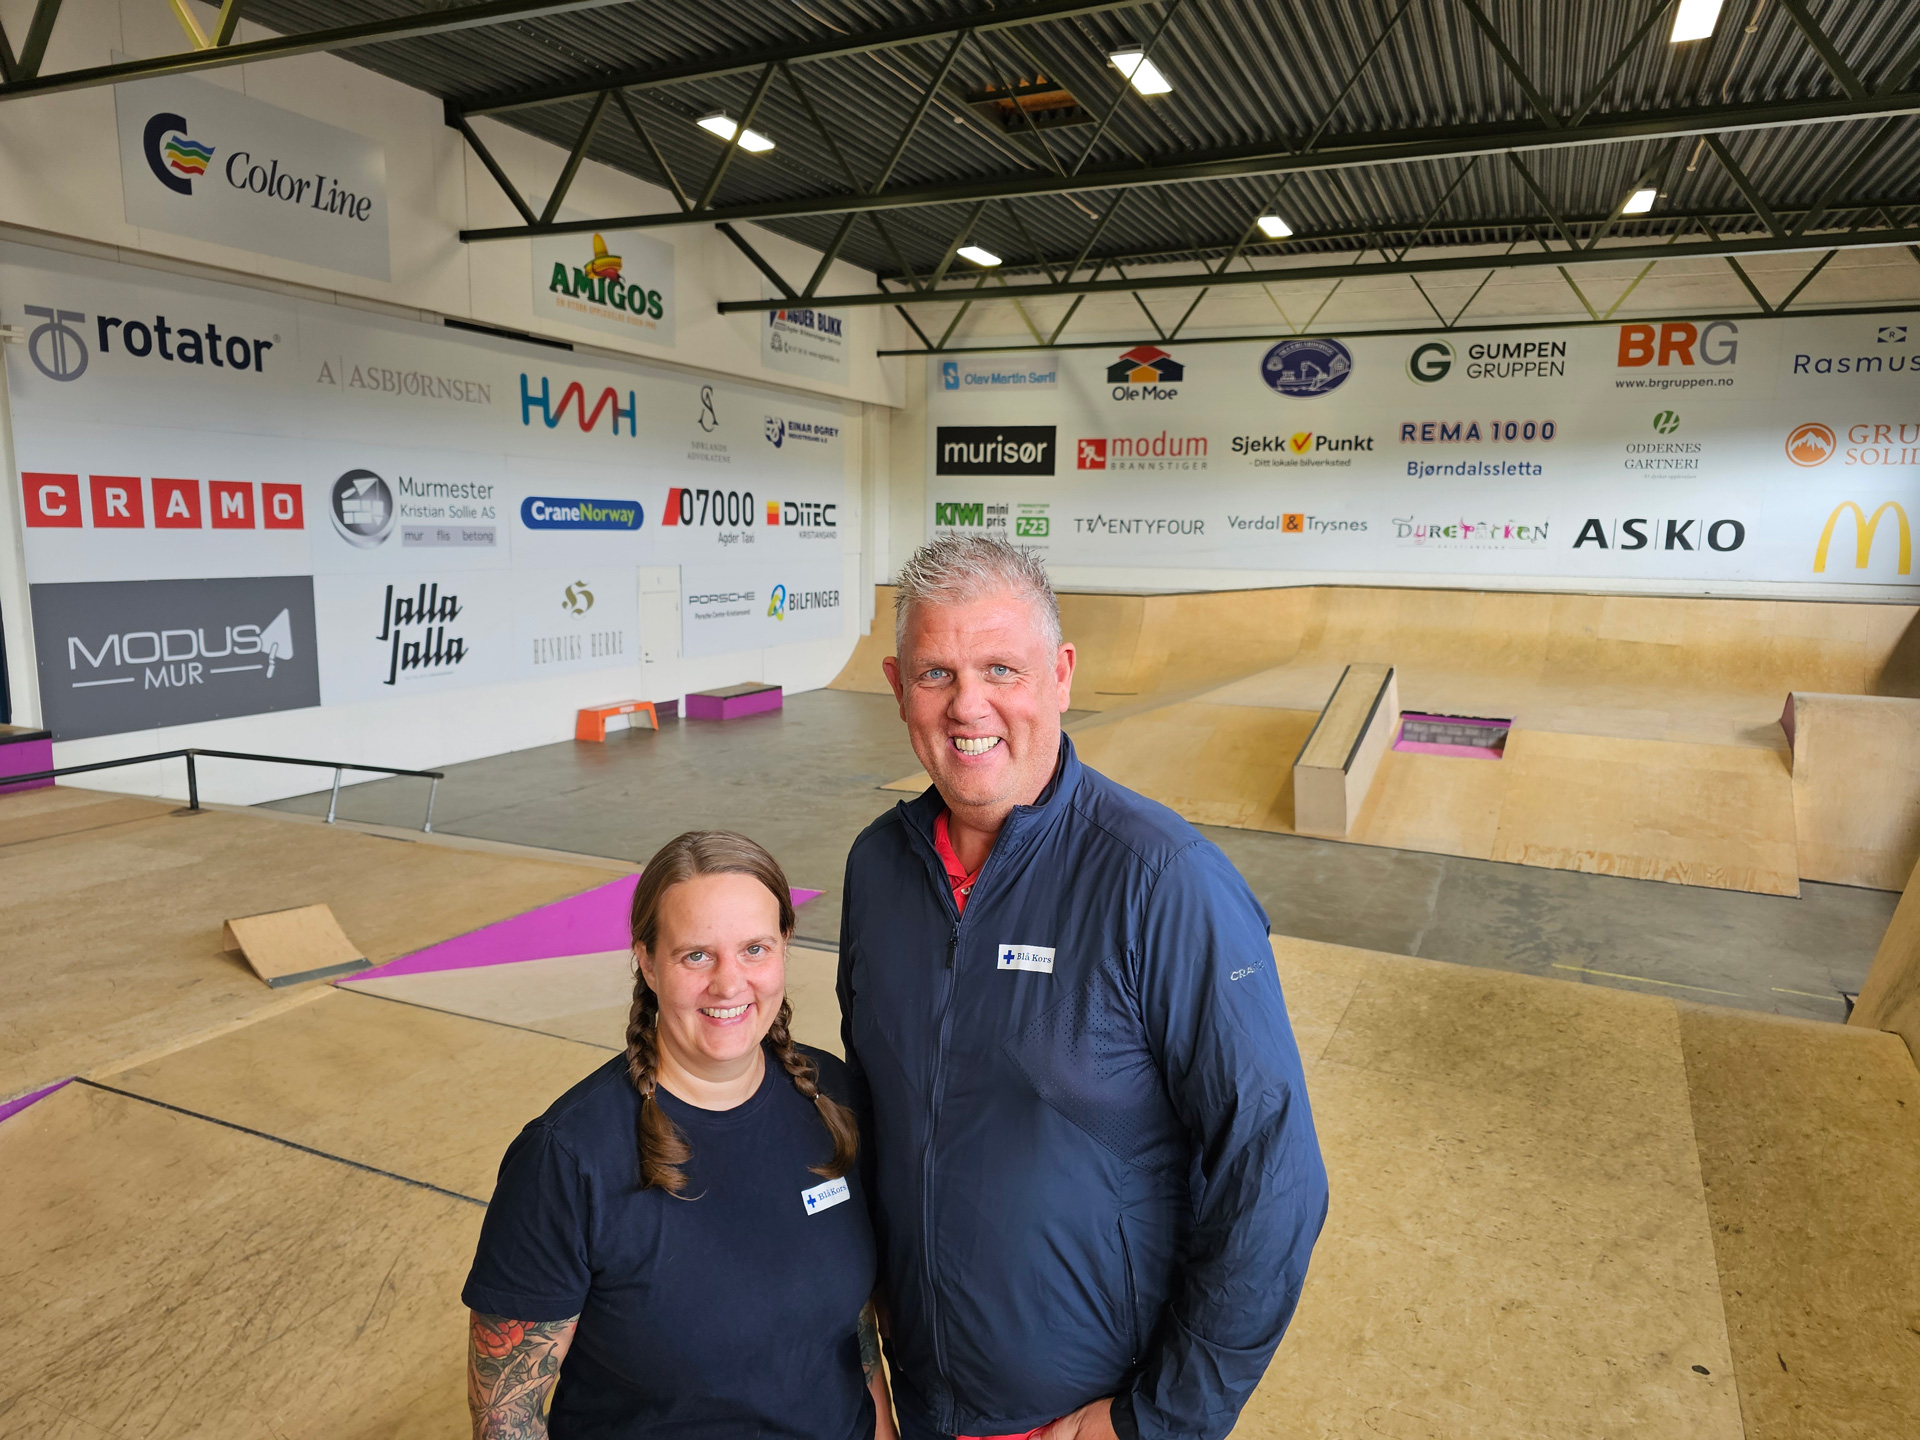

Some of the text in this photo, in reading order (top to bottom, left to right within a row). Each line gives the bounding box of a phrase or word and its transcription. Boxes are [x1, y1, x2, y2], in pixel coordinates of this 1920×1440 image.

[225, 151, 372, 222] Color Line
[549, 261, 664, 320] AMIGOS
[96, 315, 273, 373] rotator
[1468, 341, 1567, 360] GUMPEN
[1617, 321, 1738, 367] BRG
[1466, 361, 1565, 379] GRUPPEN
[1793, 354, 1920, 374] Rasmus
[349, 365, 491, 404] ASBJØRNSEN
[991, 372, 1026, 384] Martin
[1615, 377, 1734, 389] www.brgruppen.no
[1112, 385, 1178, 401] Ole Moe
[788, 421, 812, 434] EINAR
[1400, 421, 1555, 443] REMA 1000
[1848, 423, 1920, 445] GRU
[944, 434, 1048, 464] murisør
[1111, 430, 1208, 457] modum
[1231, 435, 1374, 456] Sjekk Punkt
[1625, 443, 1702, 453] ODDERNES
[1110, 462, 1208, 471] BRANNSTIGER
[1407, 461, 1542, 479] Bjørndalssletta
[1624, 459, 1699, 470] GARTNERI
[398, 476, 494, 500] Murmester
[38, 484, 294, 521] CRAMO
[400, 504, 445, 518] Kristian
[481, 506, 496, 519] AS
[679, 488, 755, 527] 07000
[986, 503, 1009, 515] mini
[531, 501, 635, 527] CraneNorway
[936, 502, 984, 526] KIWI
[986, 516, 1007, 529] pris
[1017, 519, 1047, 535] 7-23
[1227, 515, 1368, 534] Verdal & Trysnes
[462, 529, 494, 544] betong
[718, 532, 755, 547] Agder Taxi
[689, 591, 755, 605] PORSCHE
[68, 624, 262, 670] MODUS
[144, 662, 204, 690] MUR
[1016, 952, 1052, 963] Blå Kors
